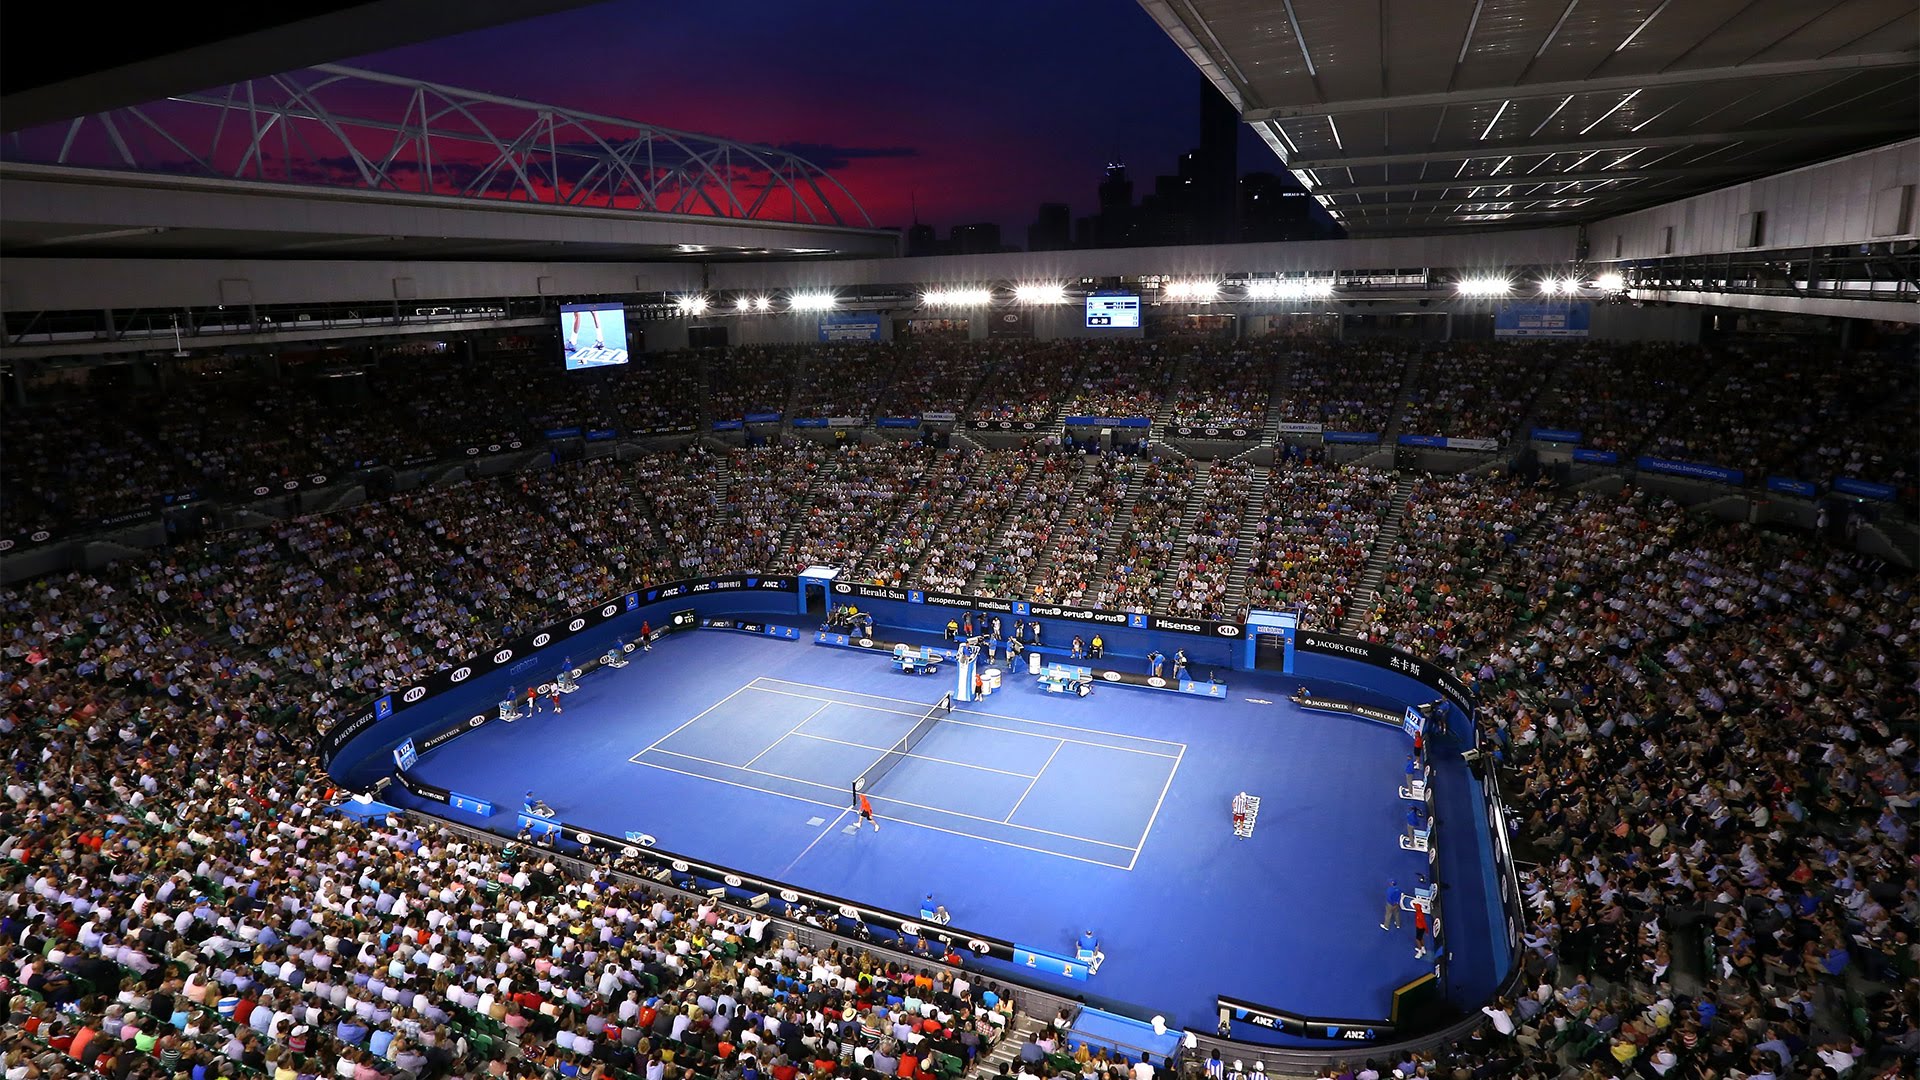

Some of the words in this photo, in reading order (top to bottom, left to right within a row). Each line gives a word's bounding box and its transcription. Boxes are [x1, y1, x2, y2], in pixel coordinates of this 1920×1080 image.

[1652, 461, 1728, 478] hotshots.tennis.com.au
[662, 588, 679, 597] ANZ
[837, 584, 850, 593] KIA
[860, 587, 887, 598] Herald
[889, 590, 905, 600] Sun
[928, 597, 972, 606] ausopen.com
[979, 602, 1011, 611] medibank
[604, 606, 616, 616] KIA
[571, 620, 584, 631] KIA
[1156, 620, 1201, 632] Hisense
[1220, 626, 1237, 635] KIA
[535, 635, 549, 646] KIA
[1345, 646, 1368, 656] CREEK
[496, 651, 511, 663] KIA
[1390, 656, 1420, 676] 杰卡斯
[453, 669, 470, 681] KIA
[406, 688, 424, 701] KIA
[355, 712, 374, 728] CREEK
[471, 716, 484, 726] KIA
[1384, 714, 1401, 722] CREEK
[1253, 1015, 1274, 1028] ANZ
[1344, 1031, 1365, 1039] ANZ
